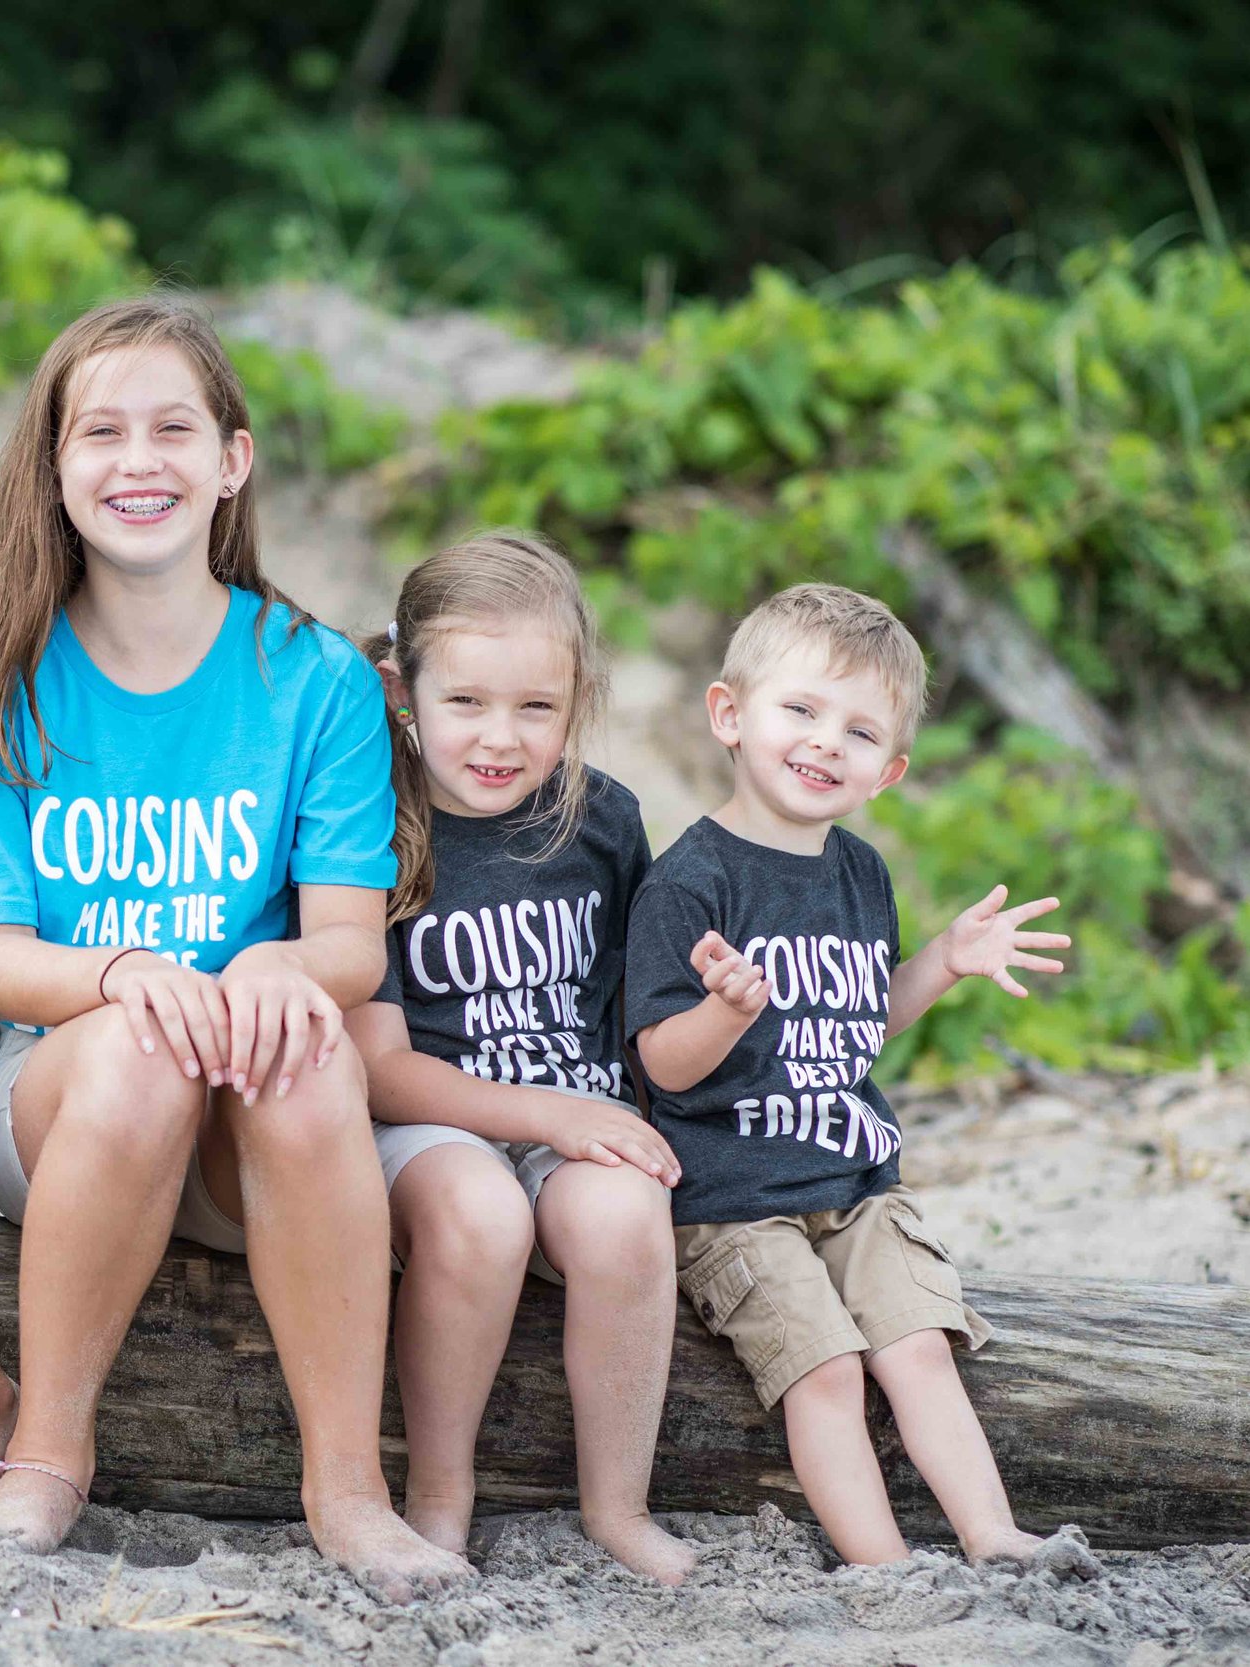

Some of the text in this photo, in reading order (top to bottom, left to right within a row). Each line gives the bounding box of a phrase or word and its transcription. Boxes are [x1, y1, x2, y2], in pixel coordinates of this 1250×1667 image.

[31, 789, 259, 888] COUSINS
[71, 893, 226, 947] MAKE THE
[410, 890, 602, 994] COUSINS
[464, 982, 587, 1037] MAKE THE
[777, 1017, 850, 1060] MAKE
[783, 1056, 873, 1090] BEST O
